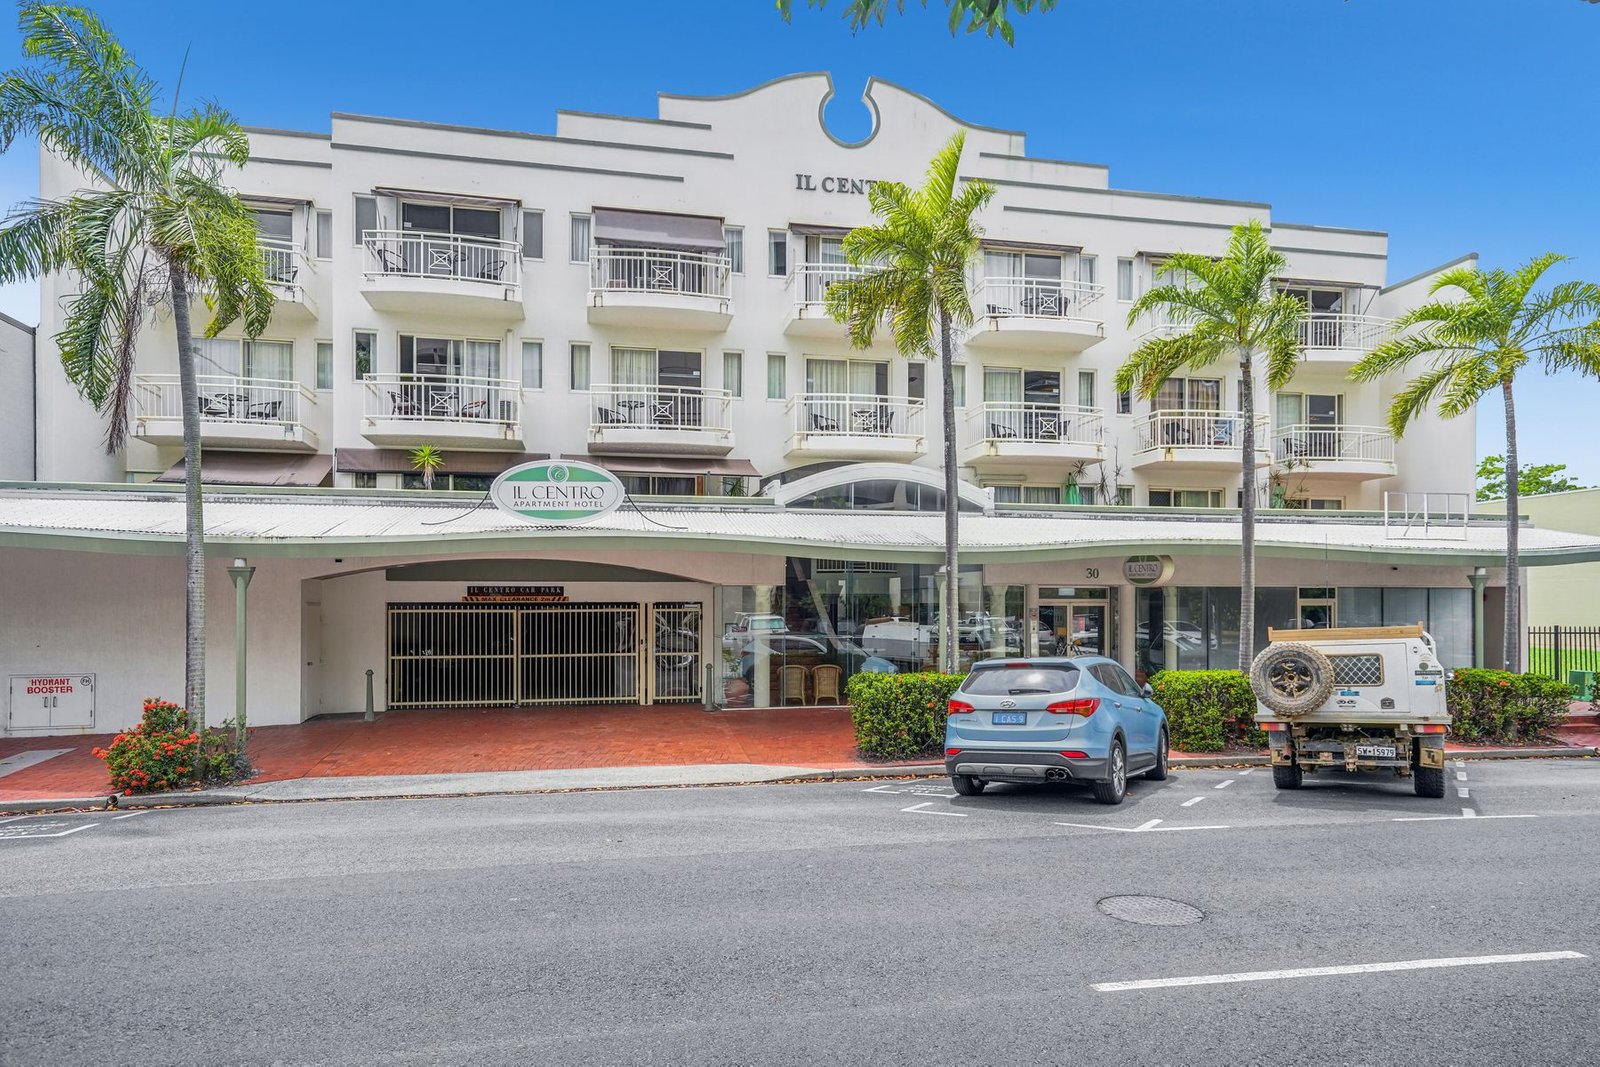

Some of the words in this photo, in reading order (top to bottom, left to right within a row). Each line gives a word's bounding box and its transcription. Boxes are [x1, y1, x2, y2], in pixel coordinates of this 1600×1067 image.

[795, 173, 817, 191] IL
[513, 485, 527, 499] IL
[532, 485, 605, 500] CENTRO
[1086, 567, 1100, 579] 30
[1134, 563, 1158, 573] CENTRO
[31, 678, 71, 686] HYDRANT
[27, 686, 73, 694] BOOSTER
